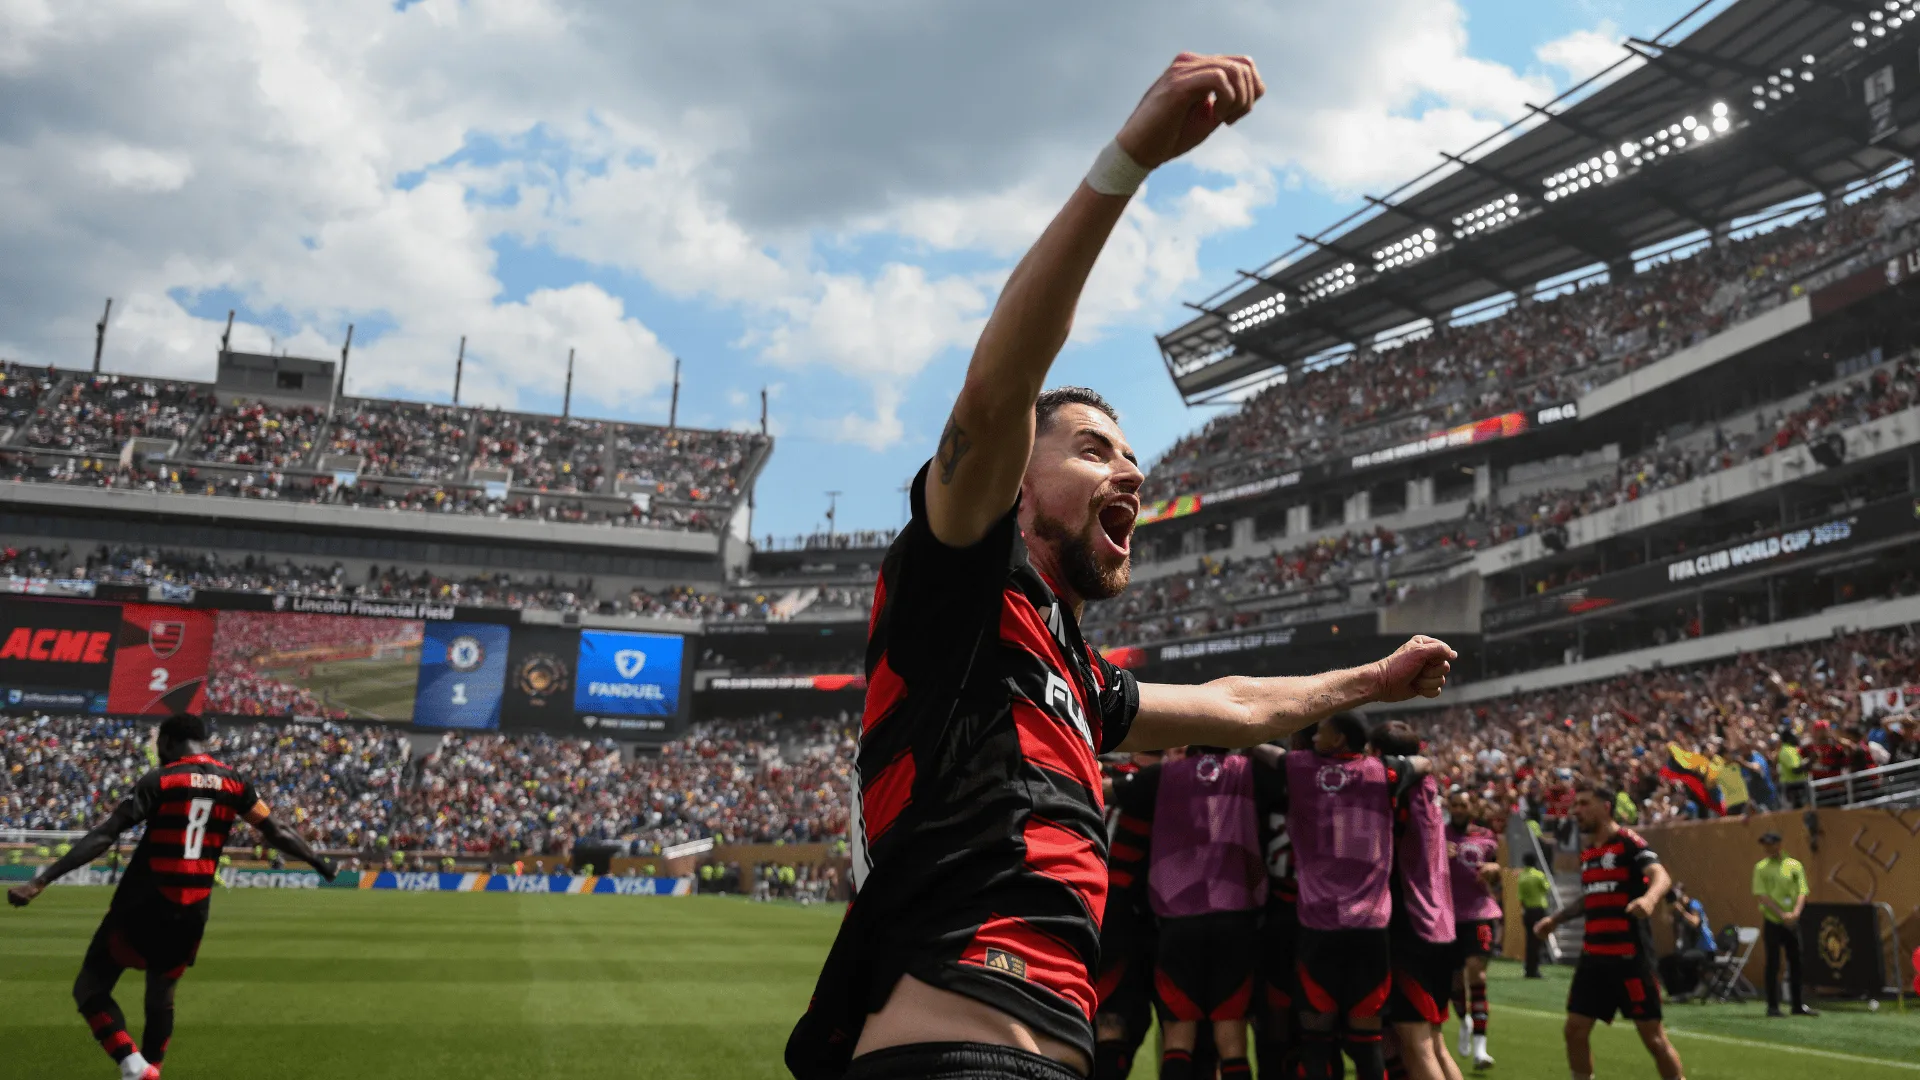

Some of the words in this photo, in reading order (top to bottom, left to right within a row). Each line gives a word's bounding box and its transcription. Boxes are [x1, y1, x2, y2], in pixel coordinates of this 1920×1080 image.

[1668, 559, 1696, 581] FIFA
[1696, 550, 1730, 575] CLUB
[1729, 536, 1780, 566] WORLD
[1780, 529, 1811, 553] CUP
[293, 597, 348, 614] Lincoln
[351, 601, 416, 618] Financial
[418, 605, 455, 620] Field
[1, 627, 112, 664] ACME
[149, 667, 169, 692] 2
[451, 684, 468, 704] 1
[588, 682, 665, 700] FANDUEL
[183, 797, 215, 860] 8
[394, 872, 440, 891] VISA
[505, 874, 549, 893] VISA
[613, 876, 656, 895] VISA
